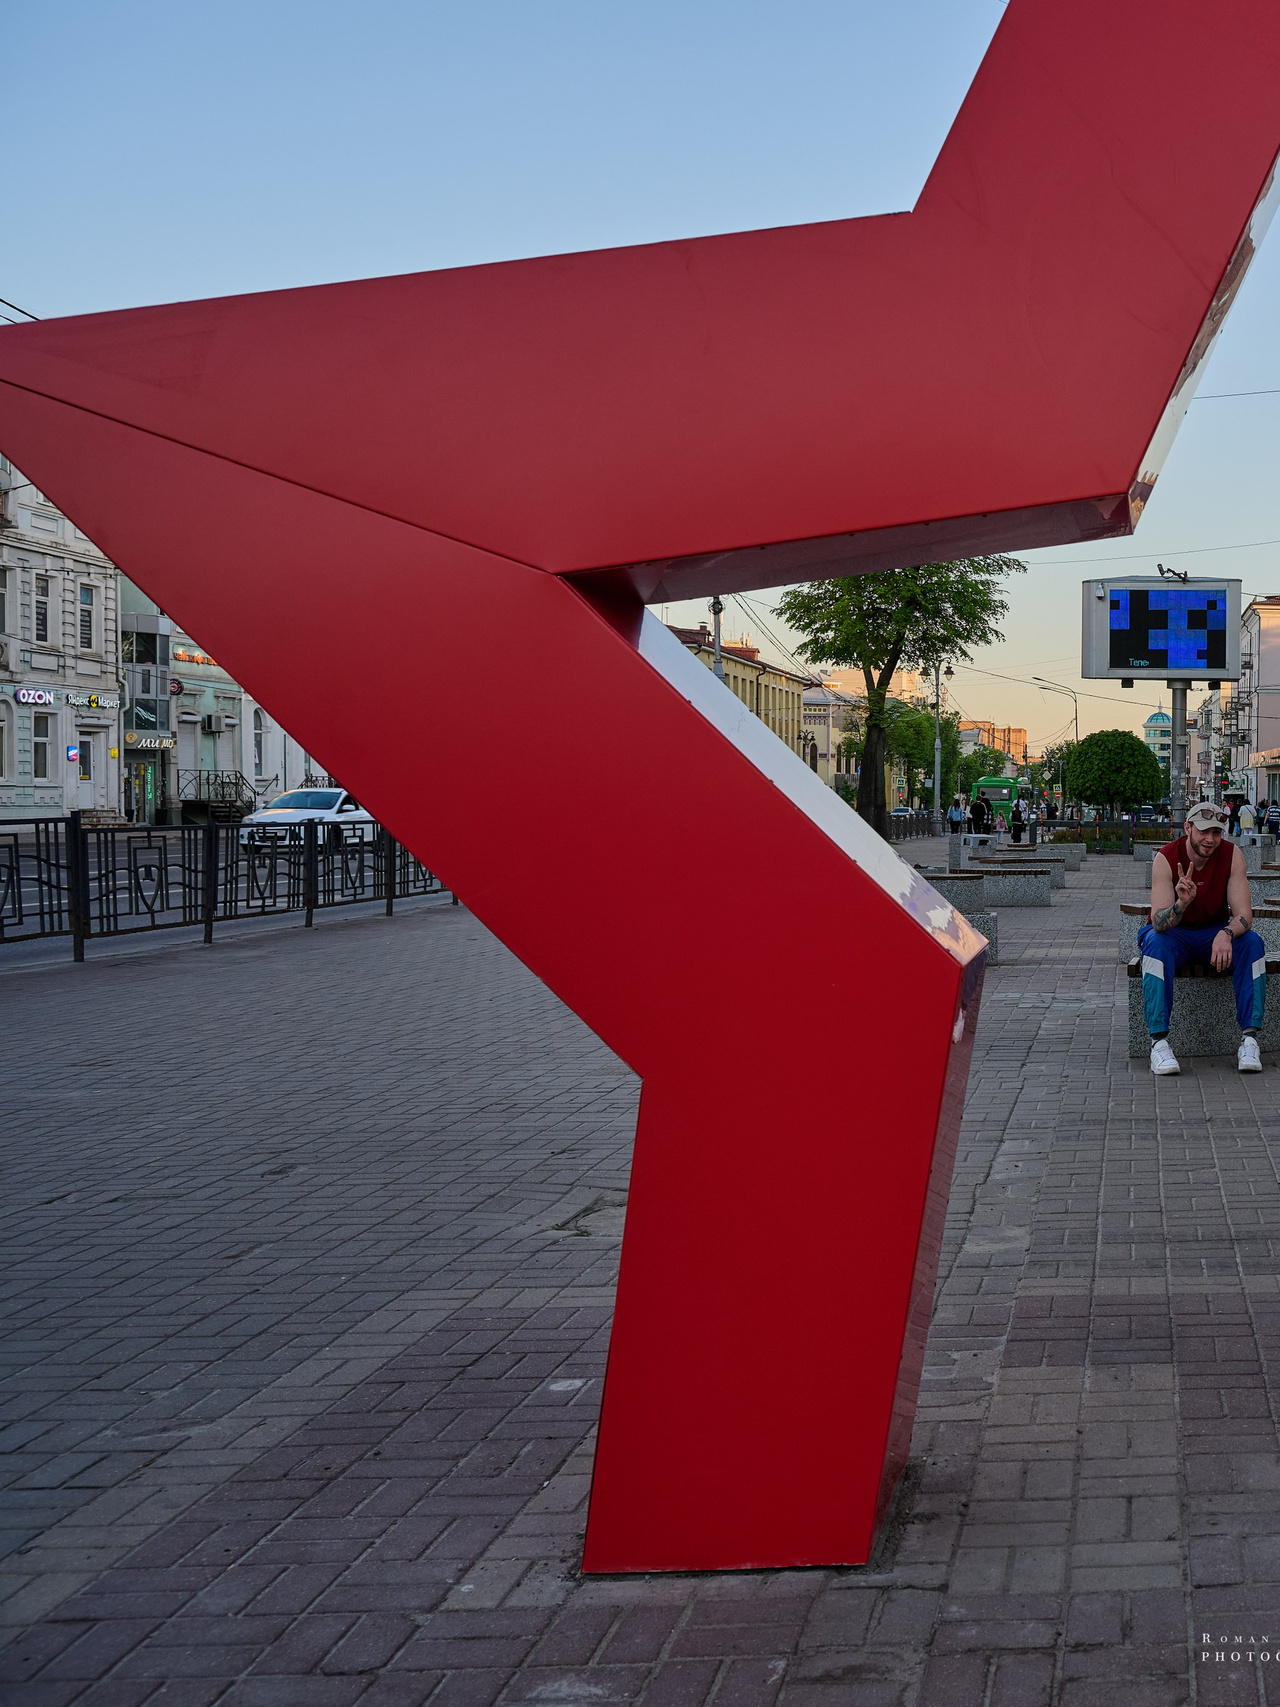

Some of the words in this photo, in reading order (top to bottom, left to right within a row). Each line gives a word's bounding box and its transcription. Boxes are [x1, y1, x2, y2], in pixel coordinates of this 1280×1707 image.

[19, 689, 54, 705] OZON
[68, 694, 90, 706] Яндекс
[98, 696, 121, 709] Маркет
